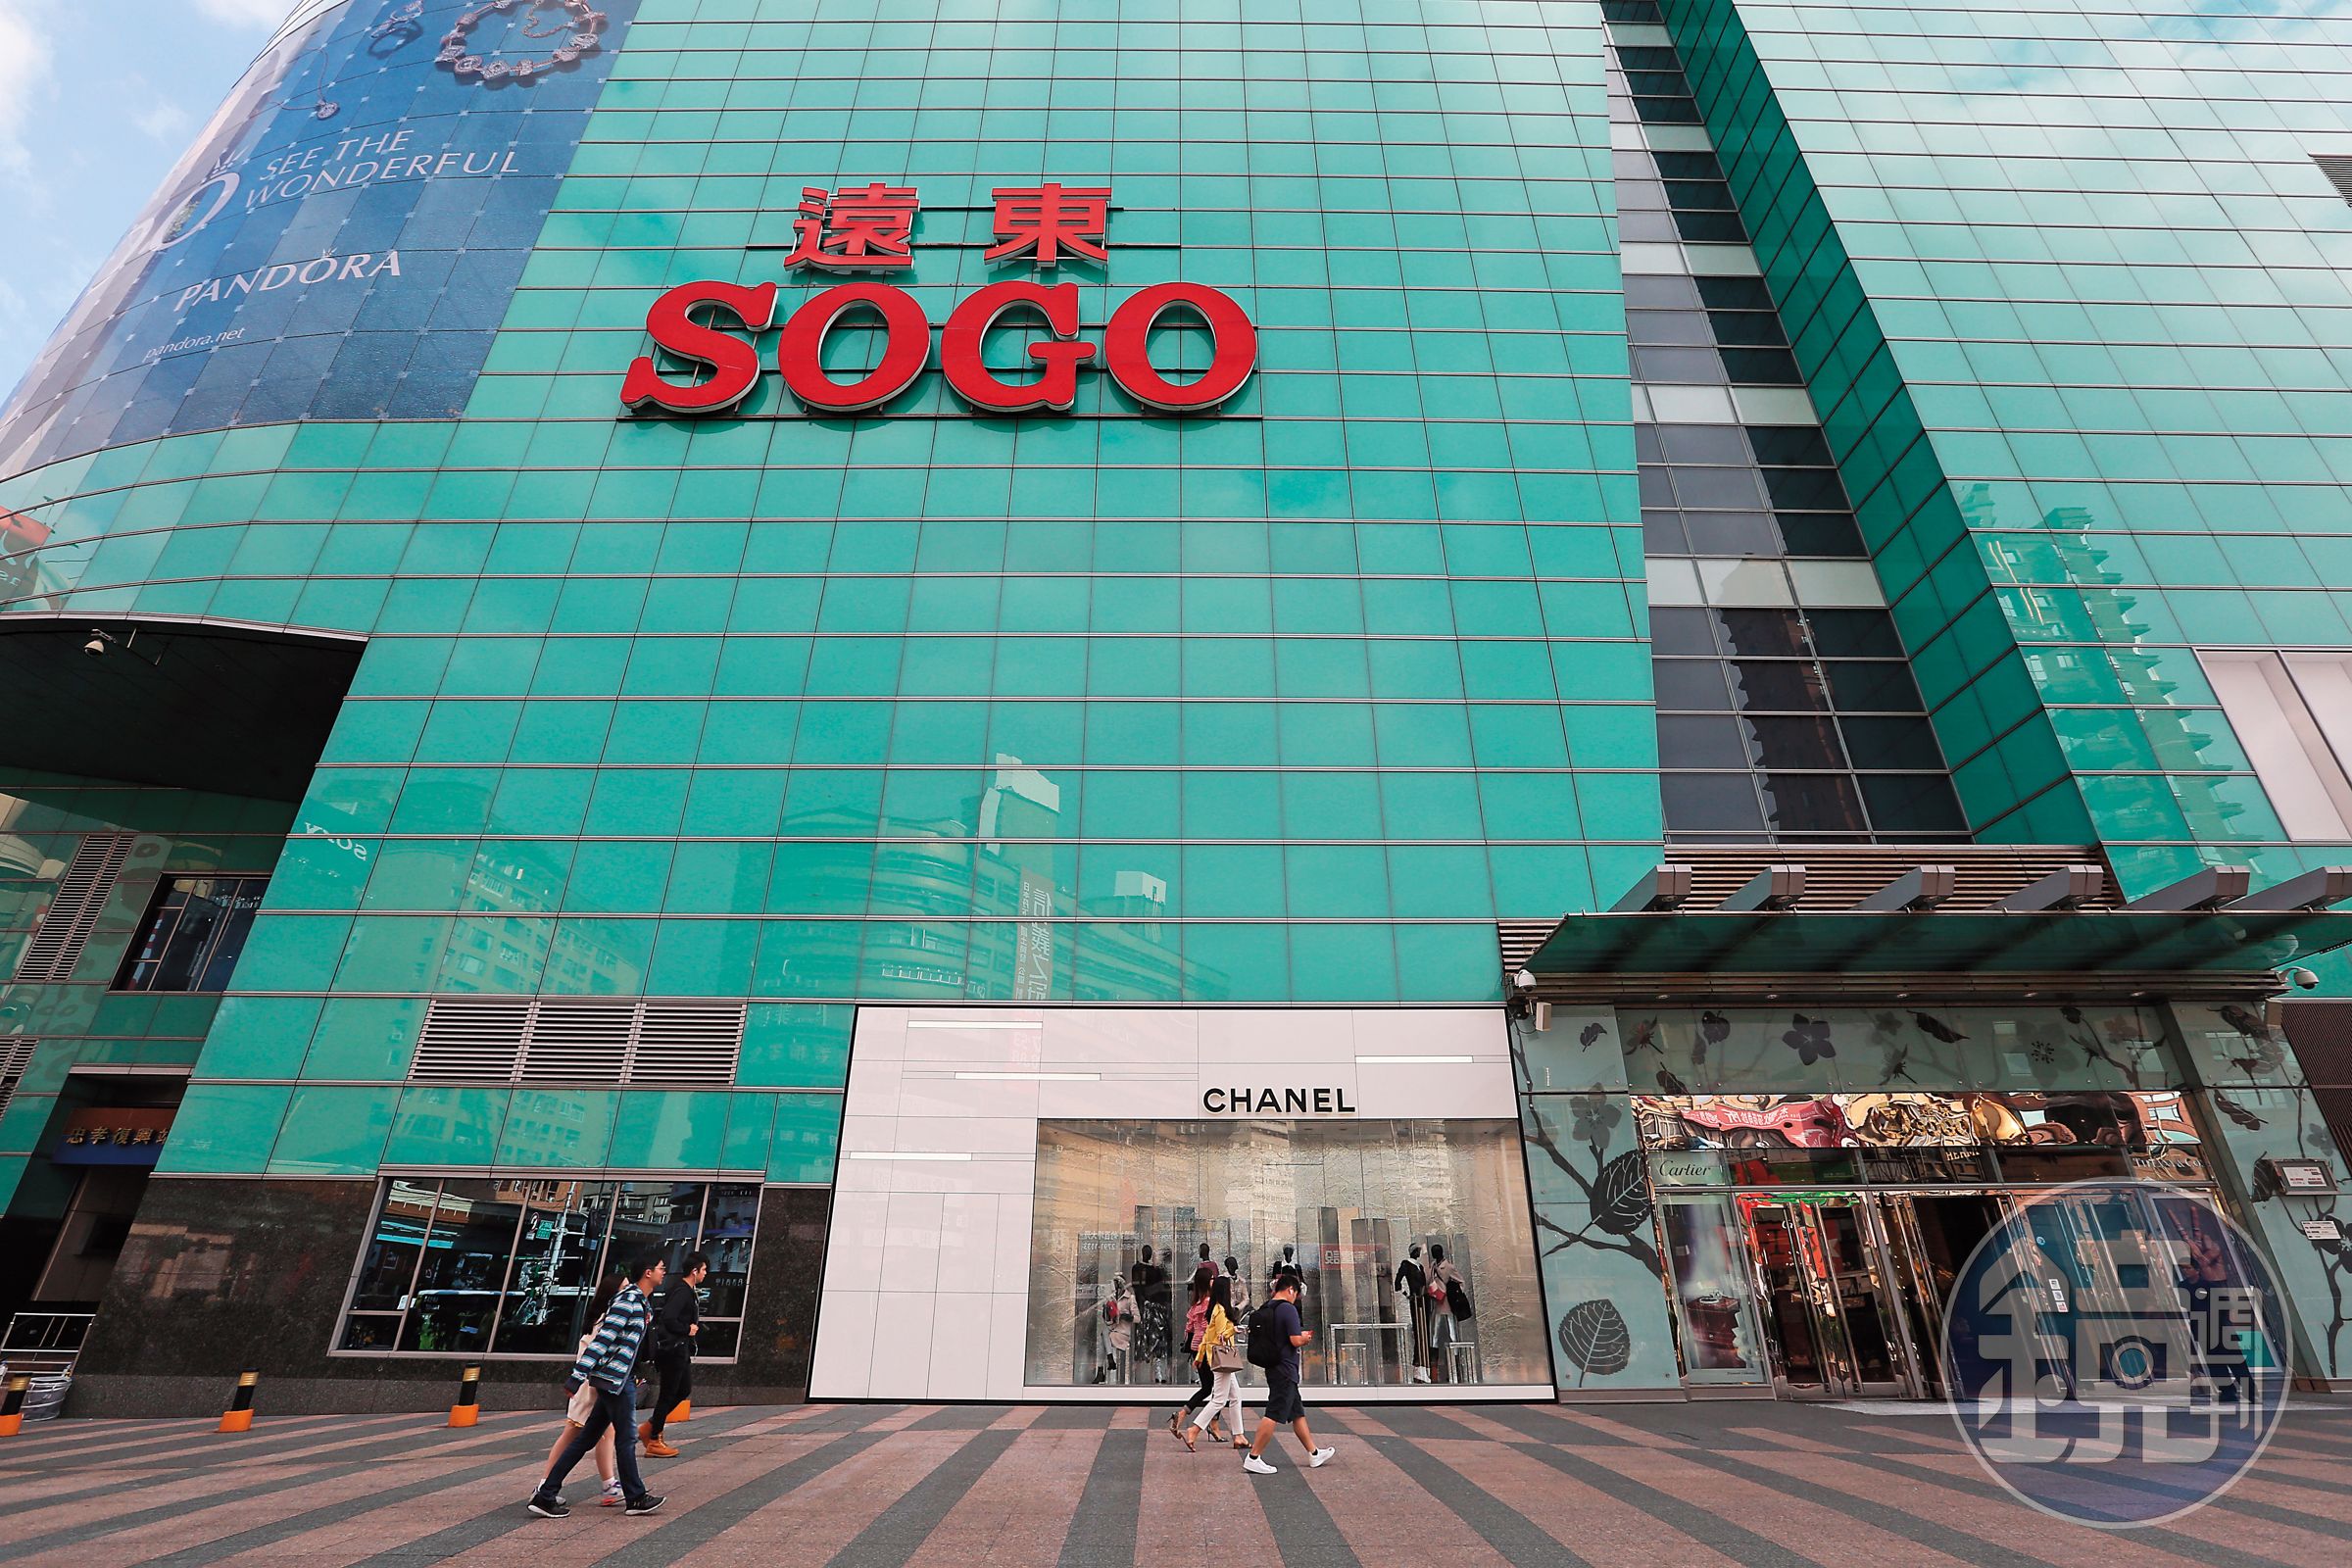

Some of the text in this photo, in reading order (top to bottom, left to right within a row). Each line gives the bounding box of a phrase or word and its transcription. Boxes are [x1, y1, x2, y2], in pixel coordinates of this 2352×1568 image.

[245, 151, 519, 209] WONDERFUL
[259, 129, 414, 180] SEE THE
[784, 182, 1113, 271] 遠東
[173, 249, 401, 313] PANDORA
[141, 327, 246, 364] pandora.net
[620, 279, 1258, 414] SOGO
[1202, 1087, 1356, 1113] CHANEL
[1659, 1160, 1712, 1177] Cartier
